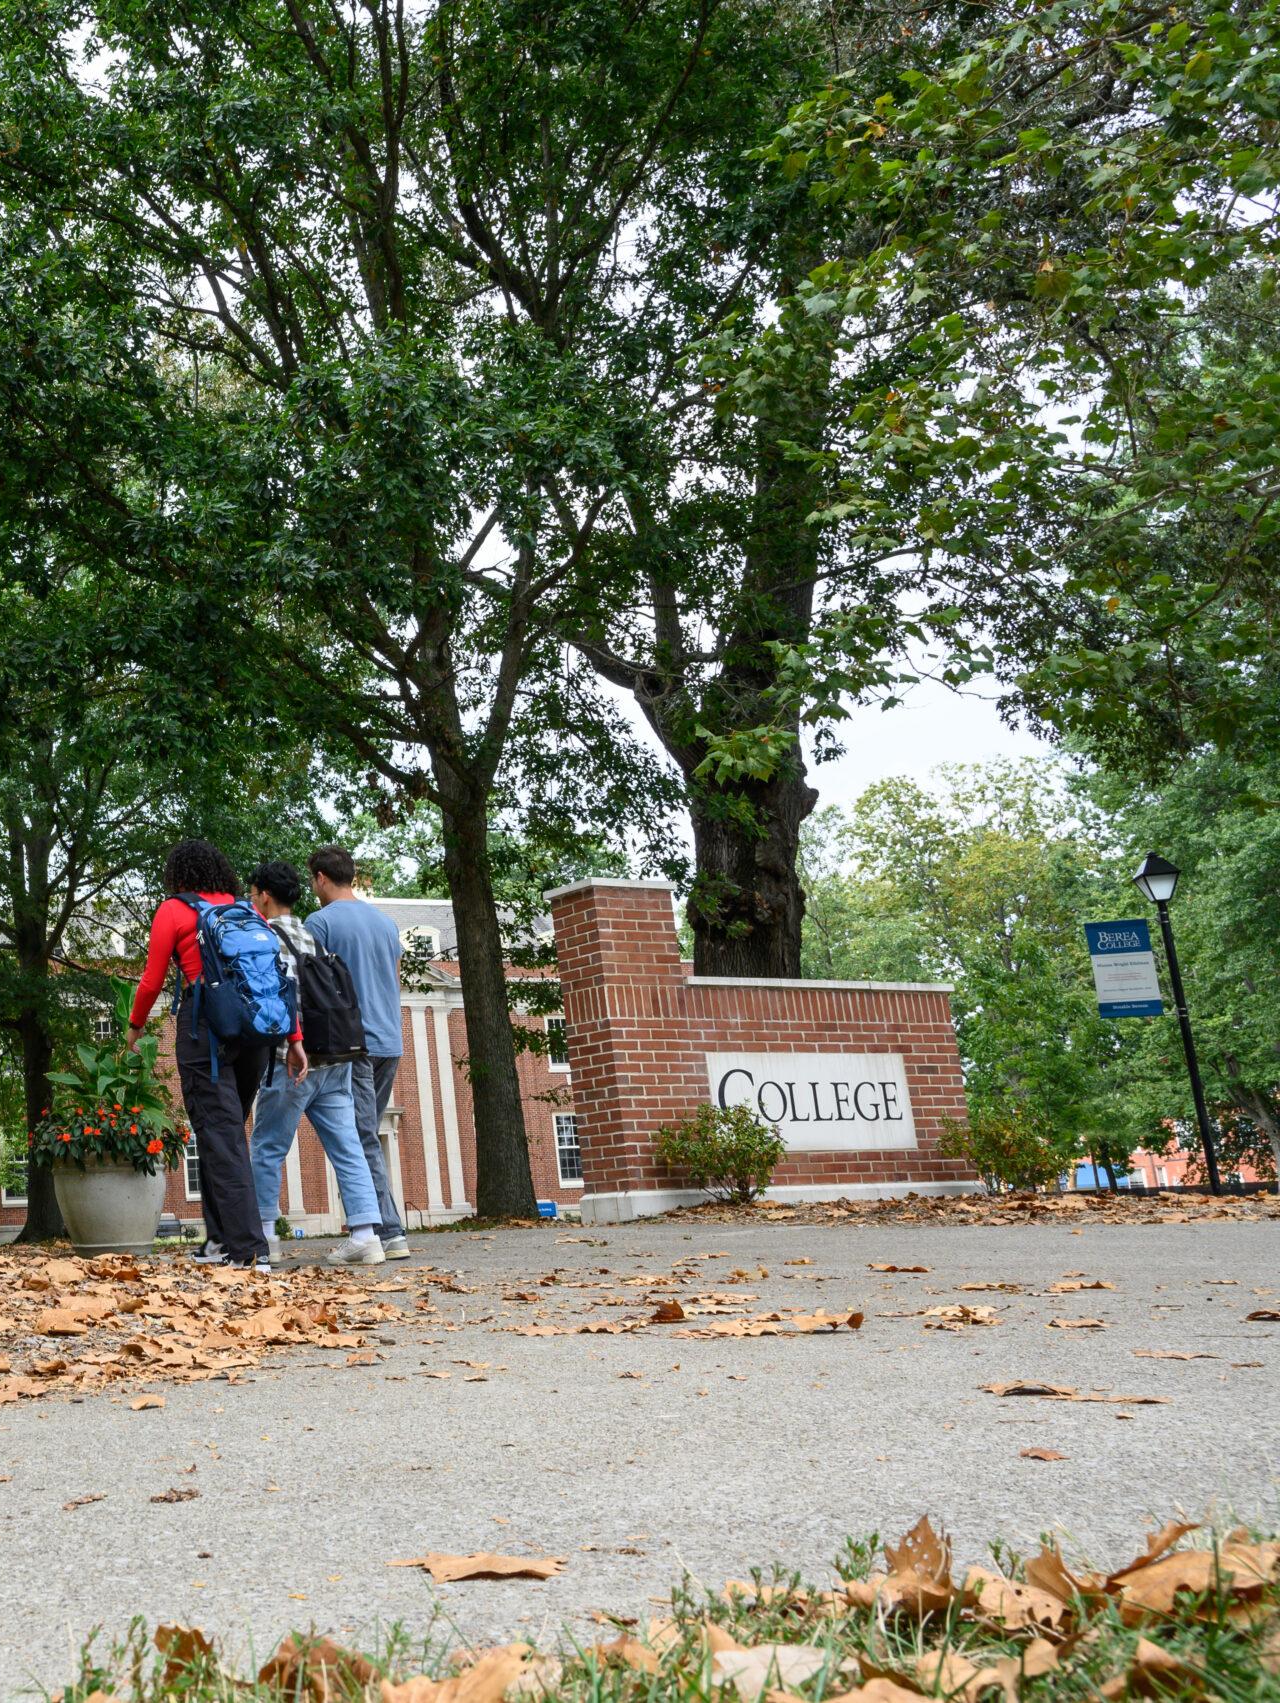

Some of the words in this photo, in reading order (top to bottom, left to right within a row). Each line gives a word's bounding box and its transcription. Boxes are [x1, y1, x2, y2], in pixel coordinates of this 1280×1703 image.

[1097, 931, 1139, 943] BEREA
[1097, 940, 1141, 950] COLLEGE
[718, 1069, 904, 1127] COLLEGE
